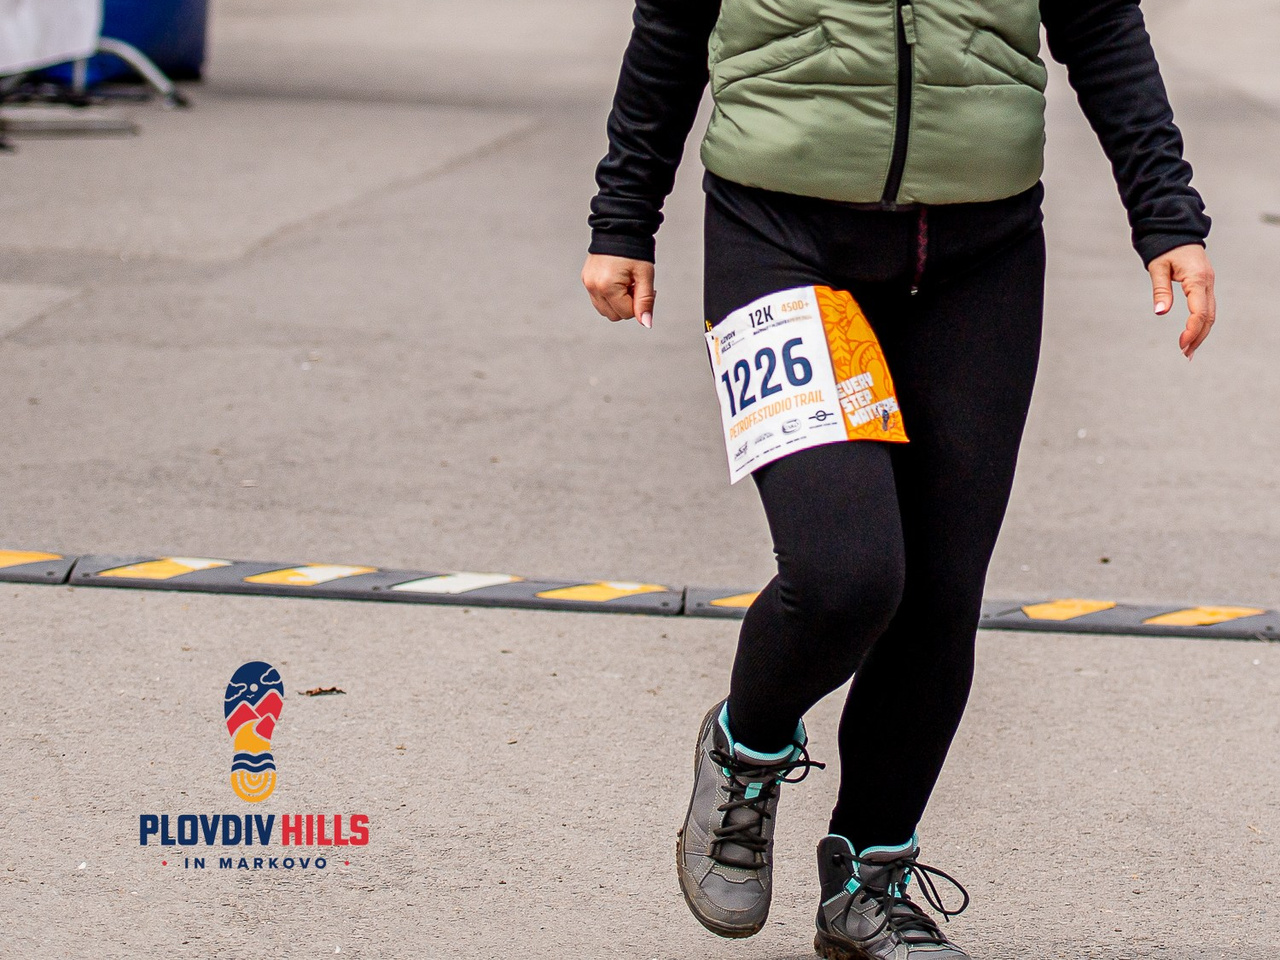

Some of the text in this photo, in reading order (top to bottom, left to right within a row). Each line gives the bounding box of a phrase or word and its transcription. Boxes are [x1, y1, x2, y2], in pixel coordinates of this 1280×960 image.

[749, 305, 774, 328] 12K
[721, 337, 813, 418] 1226
[793, 390, 825, 409] TRAIL
[840, 390, 873, 412] STEP
